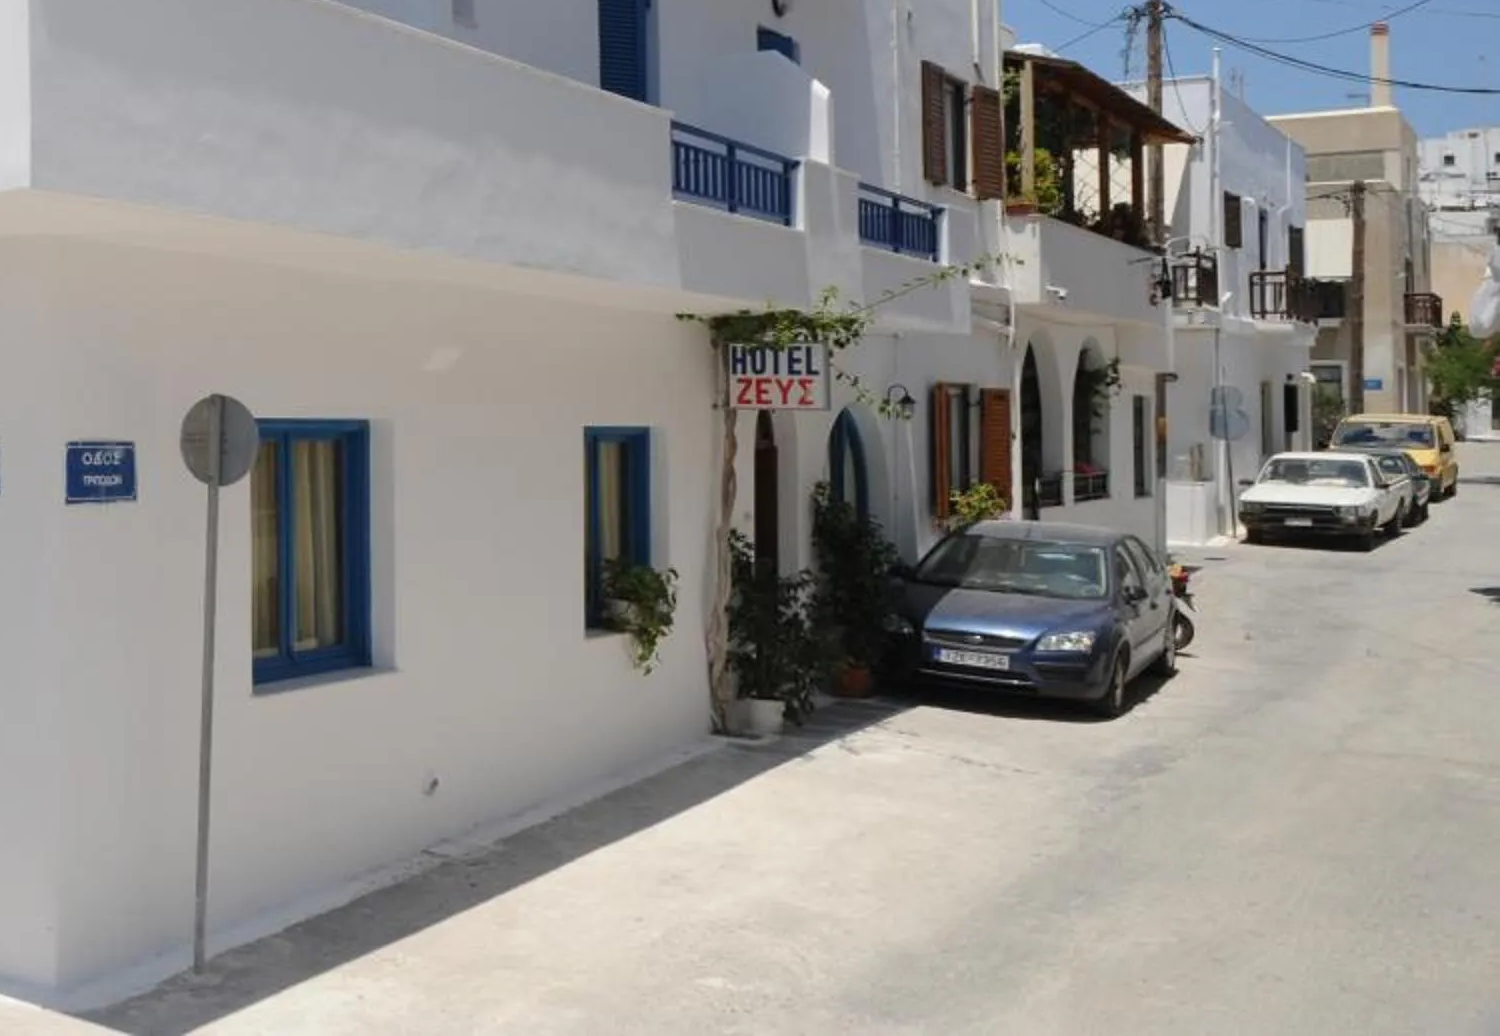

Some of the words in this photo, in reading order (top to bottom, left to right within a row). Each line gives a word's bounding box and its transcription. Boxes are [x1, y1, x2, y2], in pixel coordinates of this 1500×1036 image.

[731, 346, 819, 375] HOTEL
[737, 378, 814, 404] ΖΕΥΣ
[81, 452, 122, 466] ΟΔΟΣ
